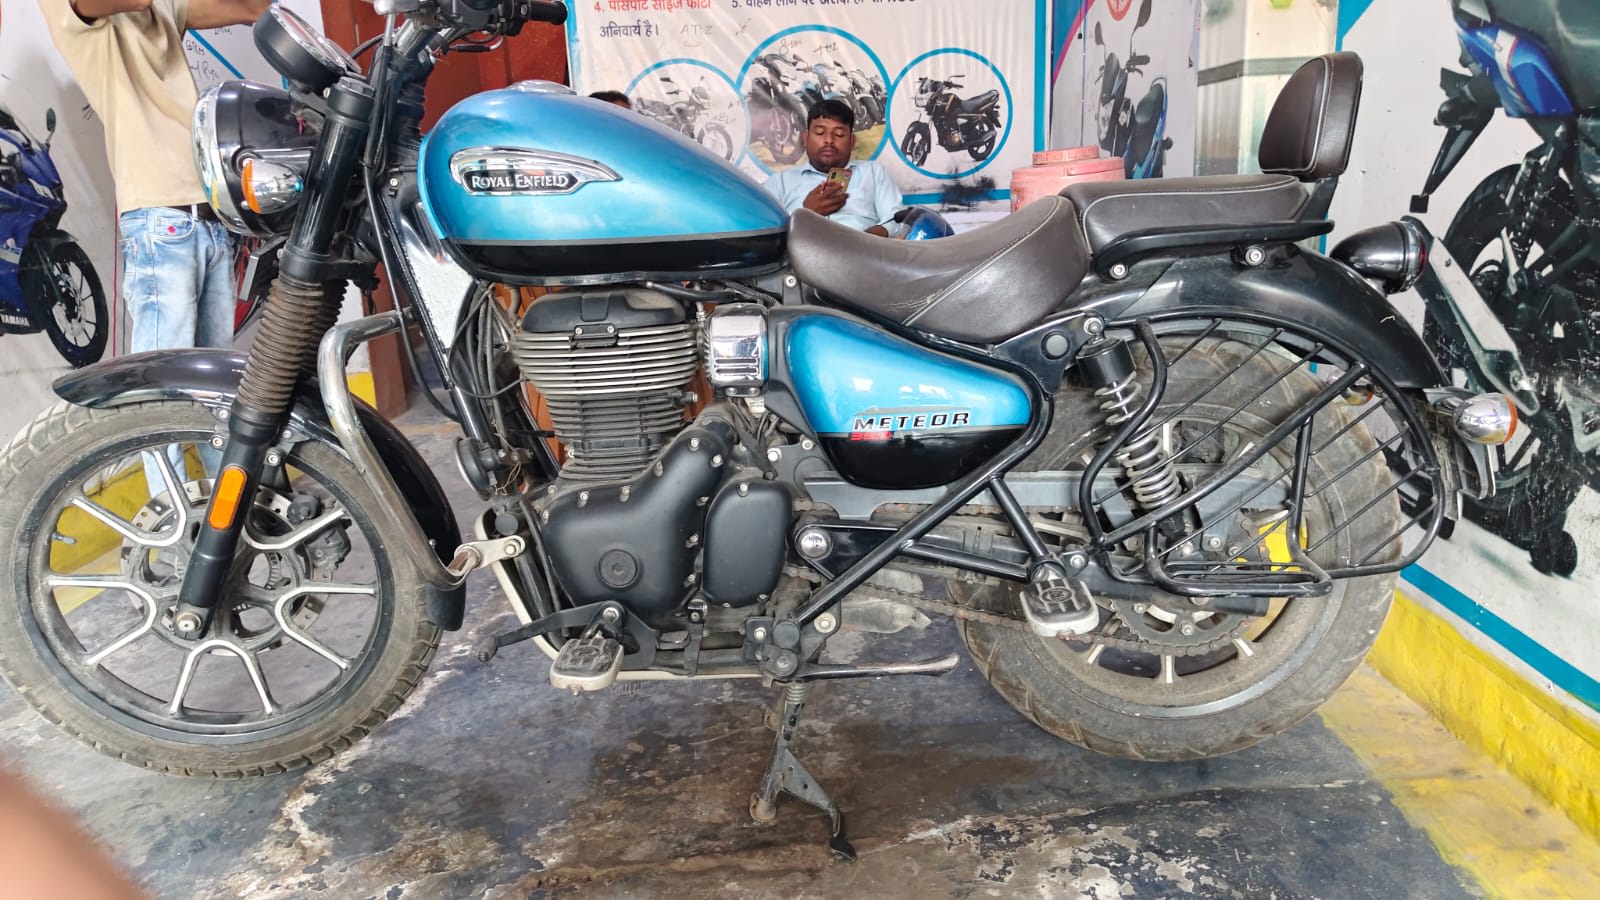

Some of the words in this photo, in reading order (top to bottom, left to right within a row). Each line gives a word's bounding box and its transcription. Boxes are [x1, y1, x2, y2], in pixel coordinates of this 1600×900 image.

[600, 20, 641, 37] अनिवार्य
[472, 176, 513, 189] ROYAL
[515, 174, 569, 188] ENFIELD
[1, 314, 30, 327] YAMAHA
[854, 412, 969, 430] METEOR
